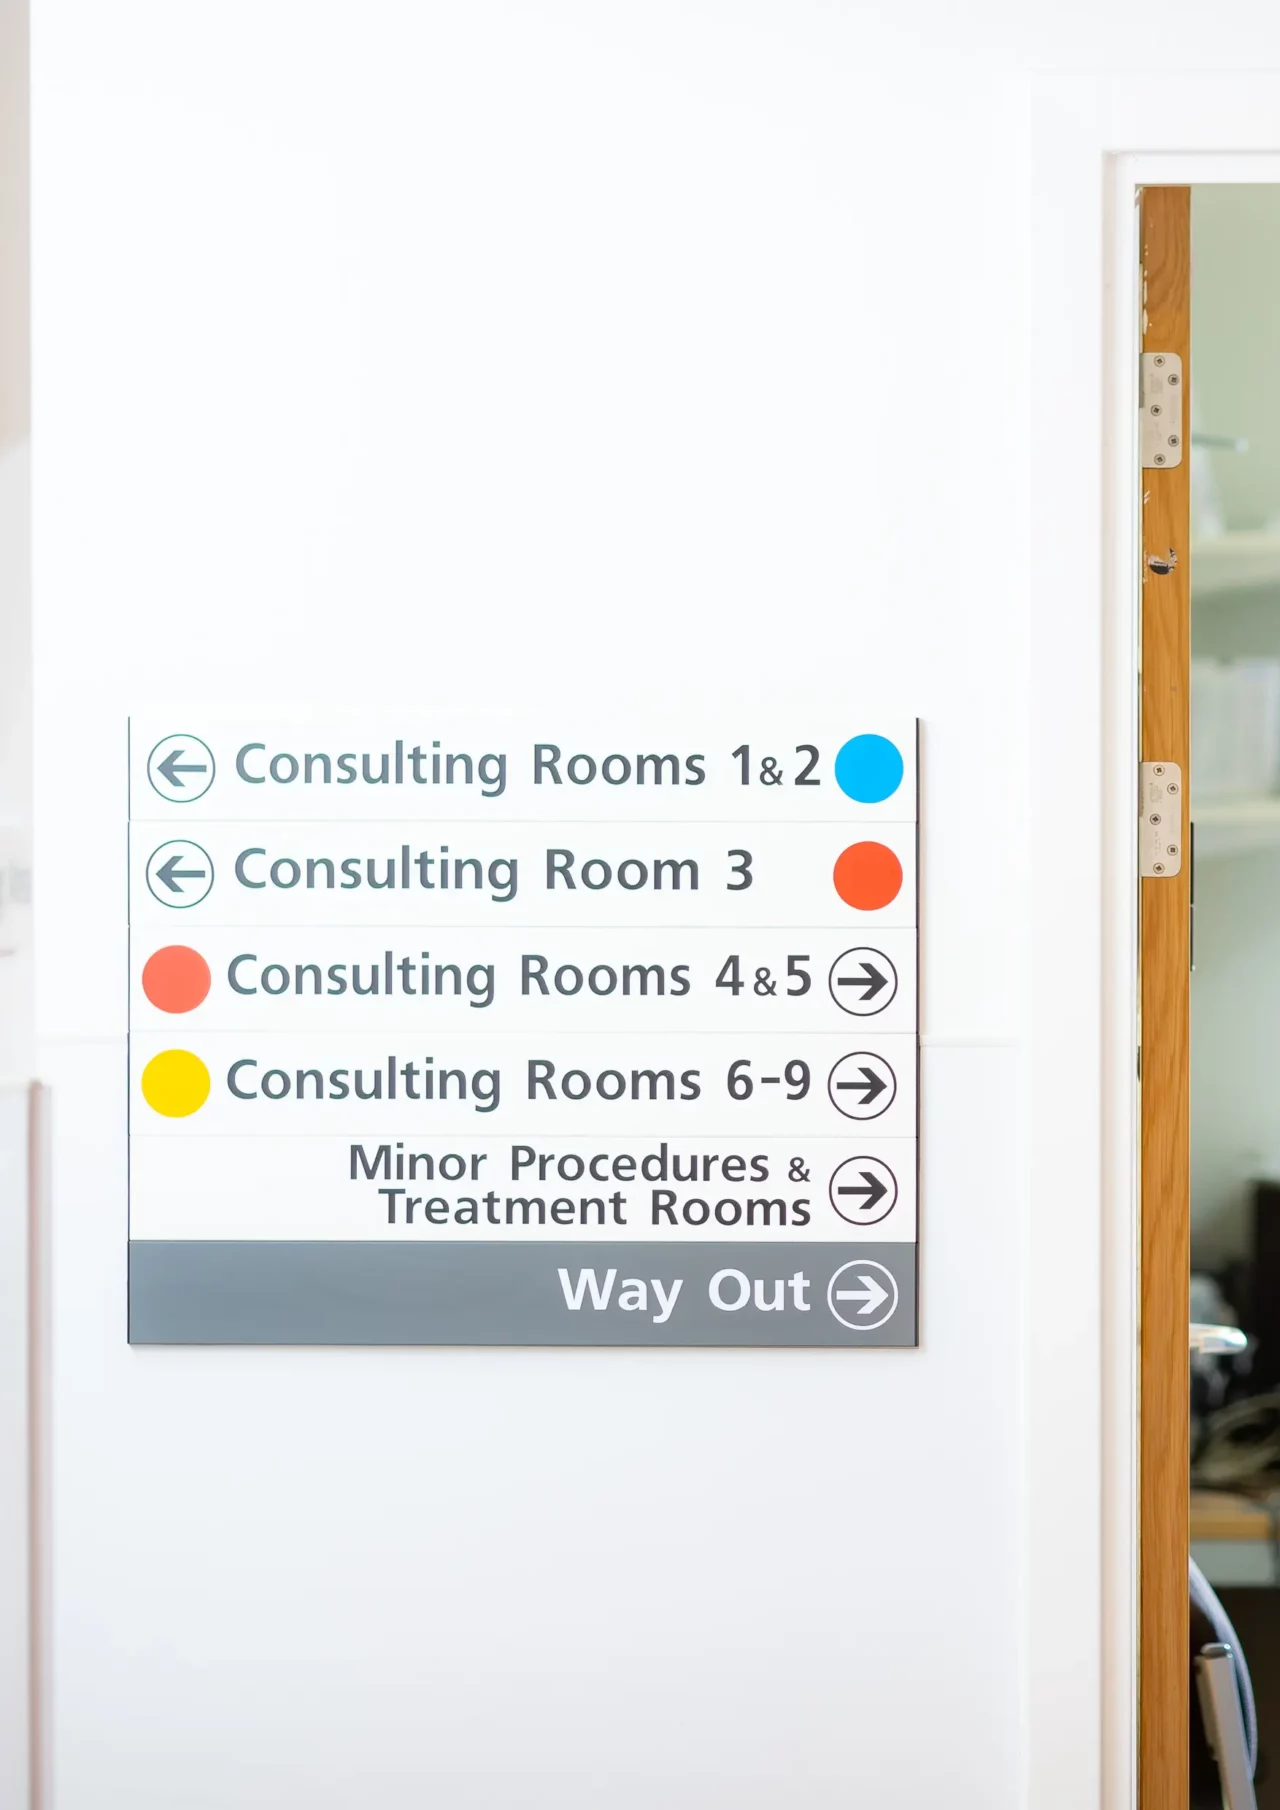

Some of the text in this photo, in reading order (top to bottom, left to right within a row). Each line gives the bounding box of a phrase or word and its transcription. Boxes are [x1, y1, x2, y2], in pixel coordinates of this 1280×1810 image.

[235, 739, 507, 798] Consulting
[533, 743, 706, 786] Rooms
[234, 844, 753, 903] Consulting Room 3
[227, 950, 495, 1009] Consulting
[521, 954, 691, 997] Rooms
[226, 1055, 501, 1113] Consulting
[527, 1059, 702, 1101] Rooms
[350, 1142, 811, 1183] Minor Procedures &
[377, 1188, 811, 1227] Treatment Rooms
[557, 1268, 811, 1324] Way Out
